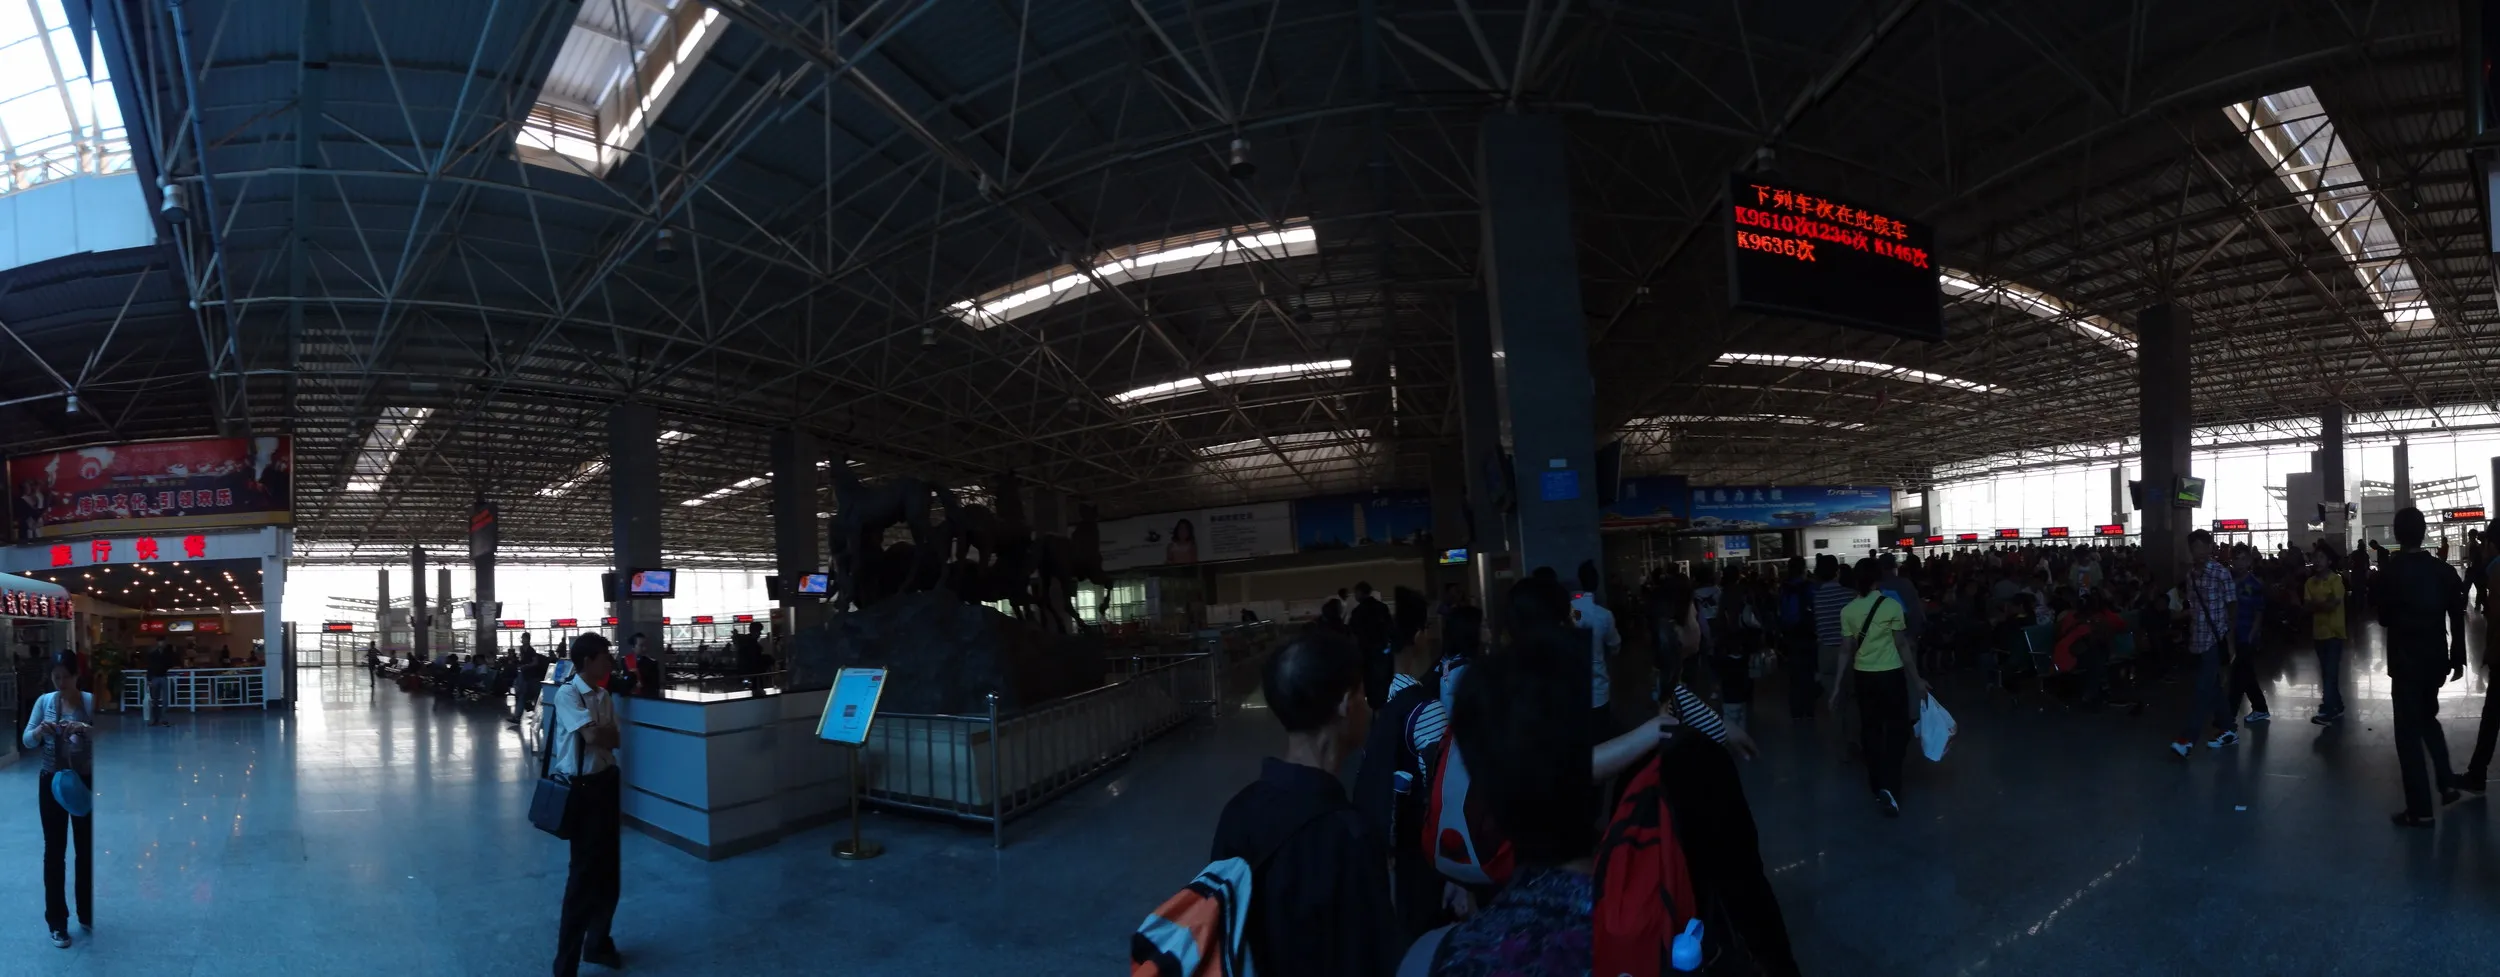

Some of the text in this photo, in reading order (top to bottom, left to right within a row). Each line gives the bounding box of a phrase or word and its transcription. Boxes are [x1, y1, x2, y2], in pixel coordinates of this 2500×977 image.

[1750, 184, 1908, 240] 下列车次在此候车
[1737, 230, 1816, 262] K9636次
[1874, 241, 1929, 269] K146次
